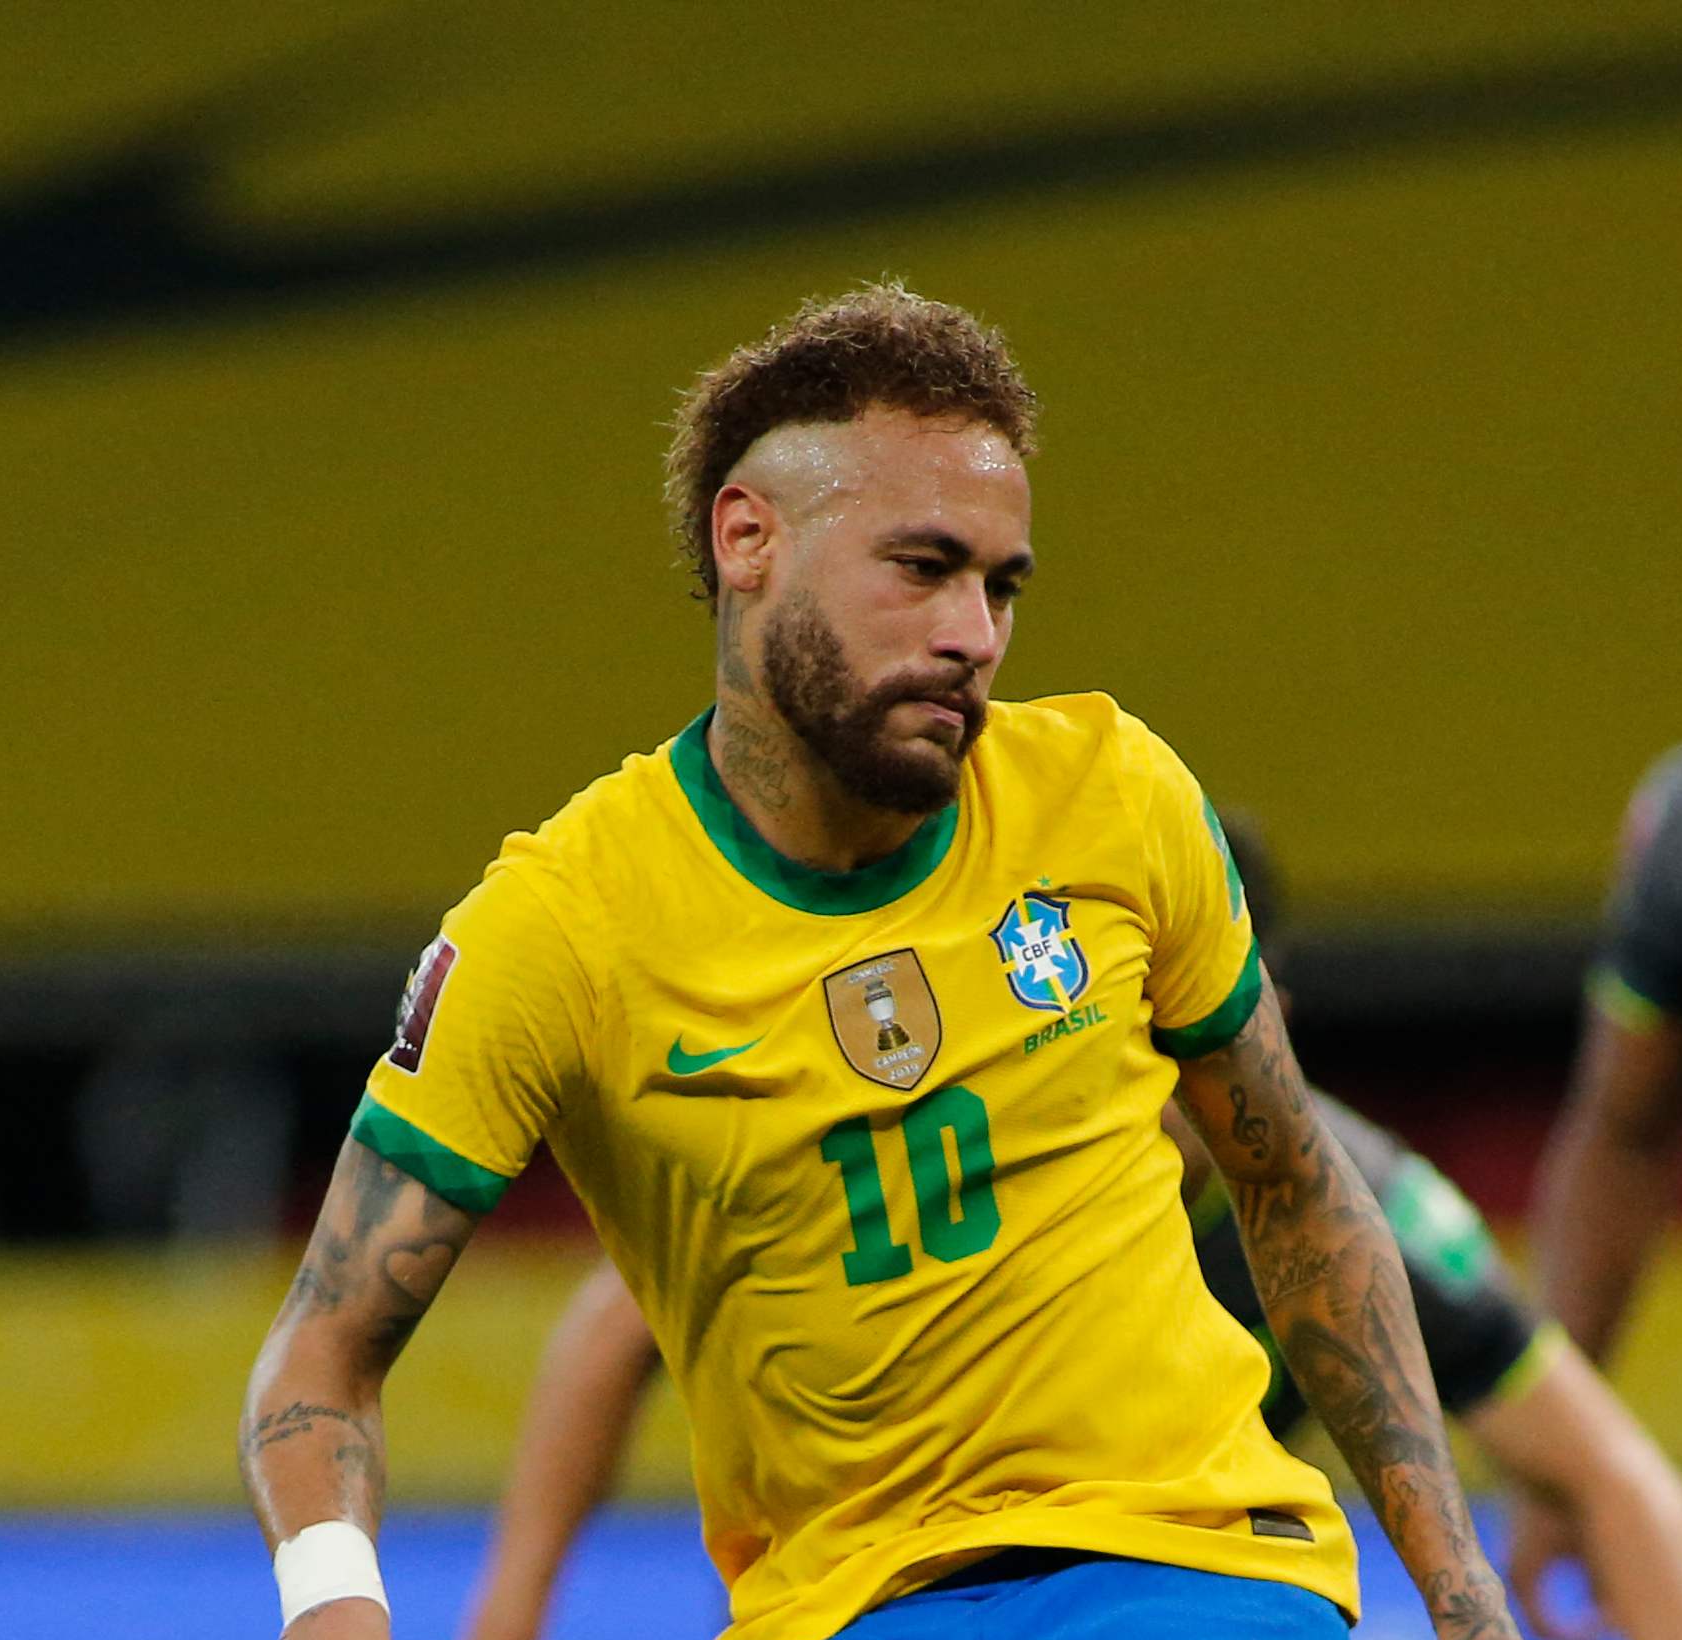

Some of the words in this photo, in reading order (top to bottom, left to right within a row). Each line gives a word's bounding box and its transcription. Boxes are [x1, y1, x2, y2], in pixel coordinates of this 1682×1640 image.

[1021, 938, 1053, 962] CBF
[1023, 1002, 1108, 1056] BRASIL
[819, 1084, 1002, 1287] 10
